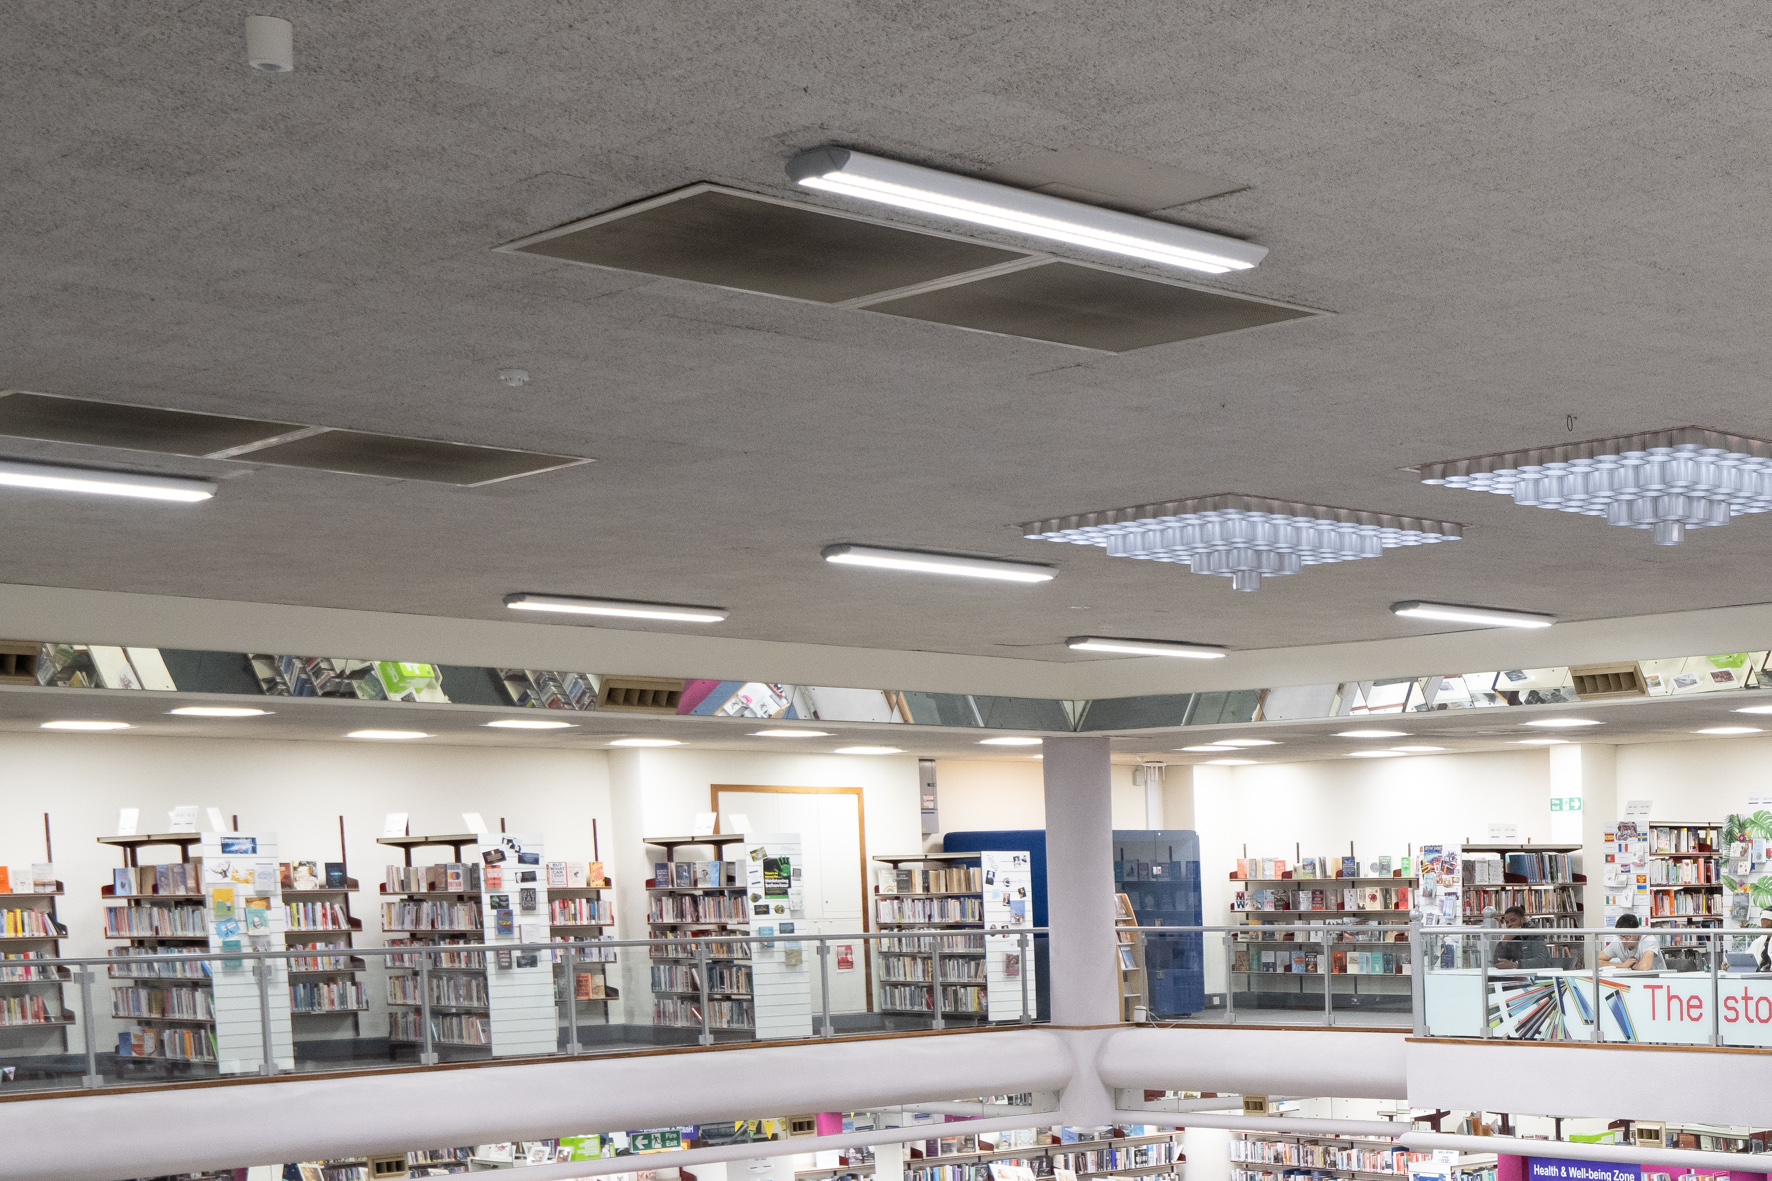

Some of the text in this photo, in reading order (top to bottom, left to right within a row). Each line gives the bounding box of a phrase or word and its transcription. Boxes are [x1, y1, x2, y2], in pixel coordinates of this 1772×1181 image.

[1643, 985, 1703, 1021] The
[1534, 1165, 1635, 1181] Health & Well-being Zone
